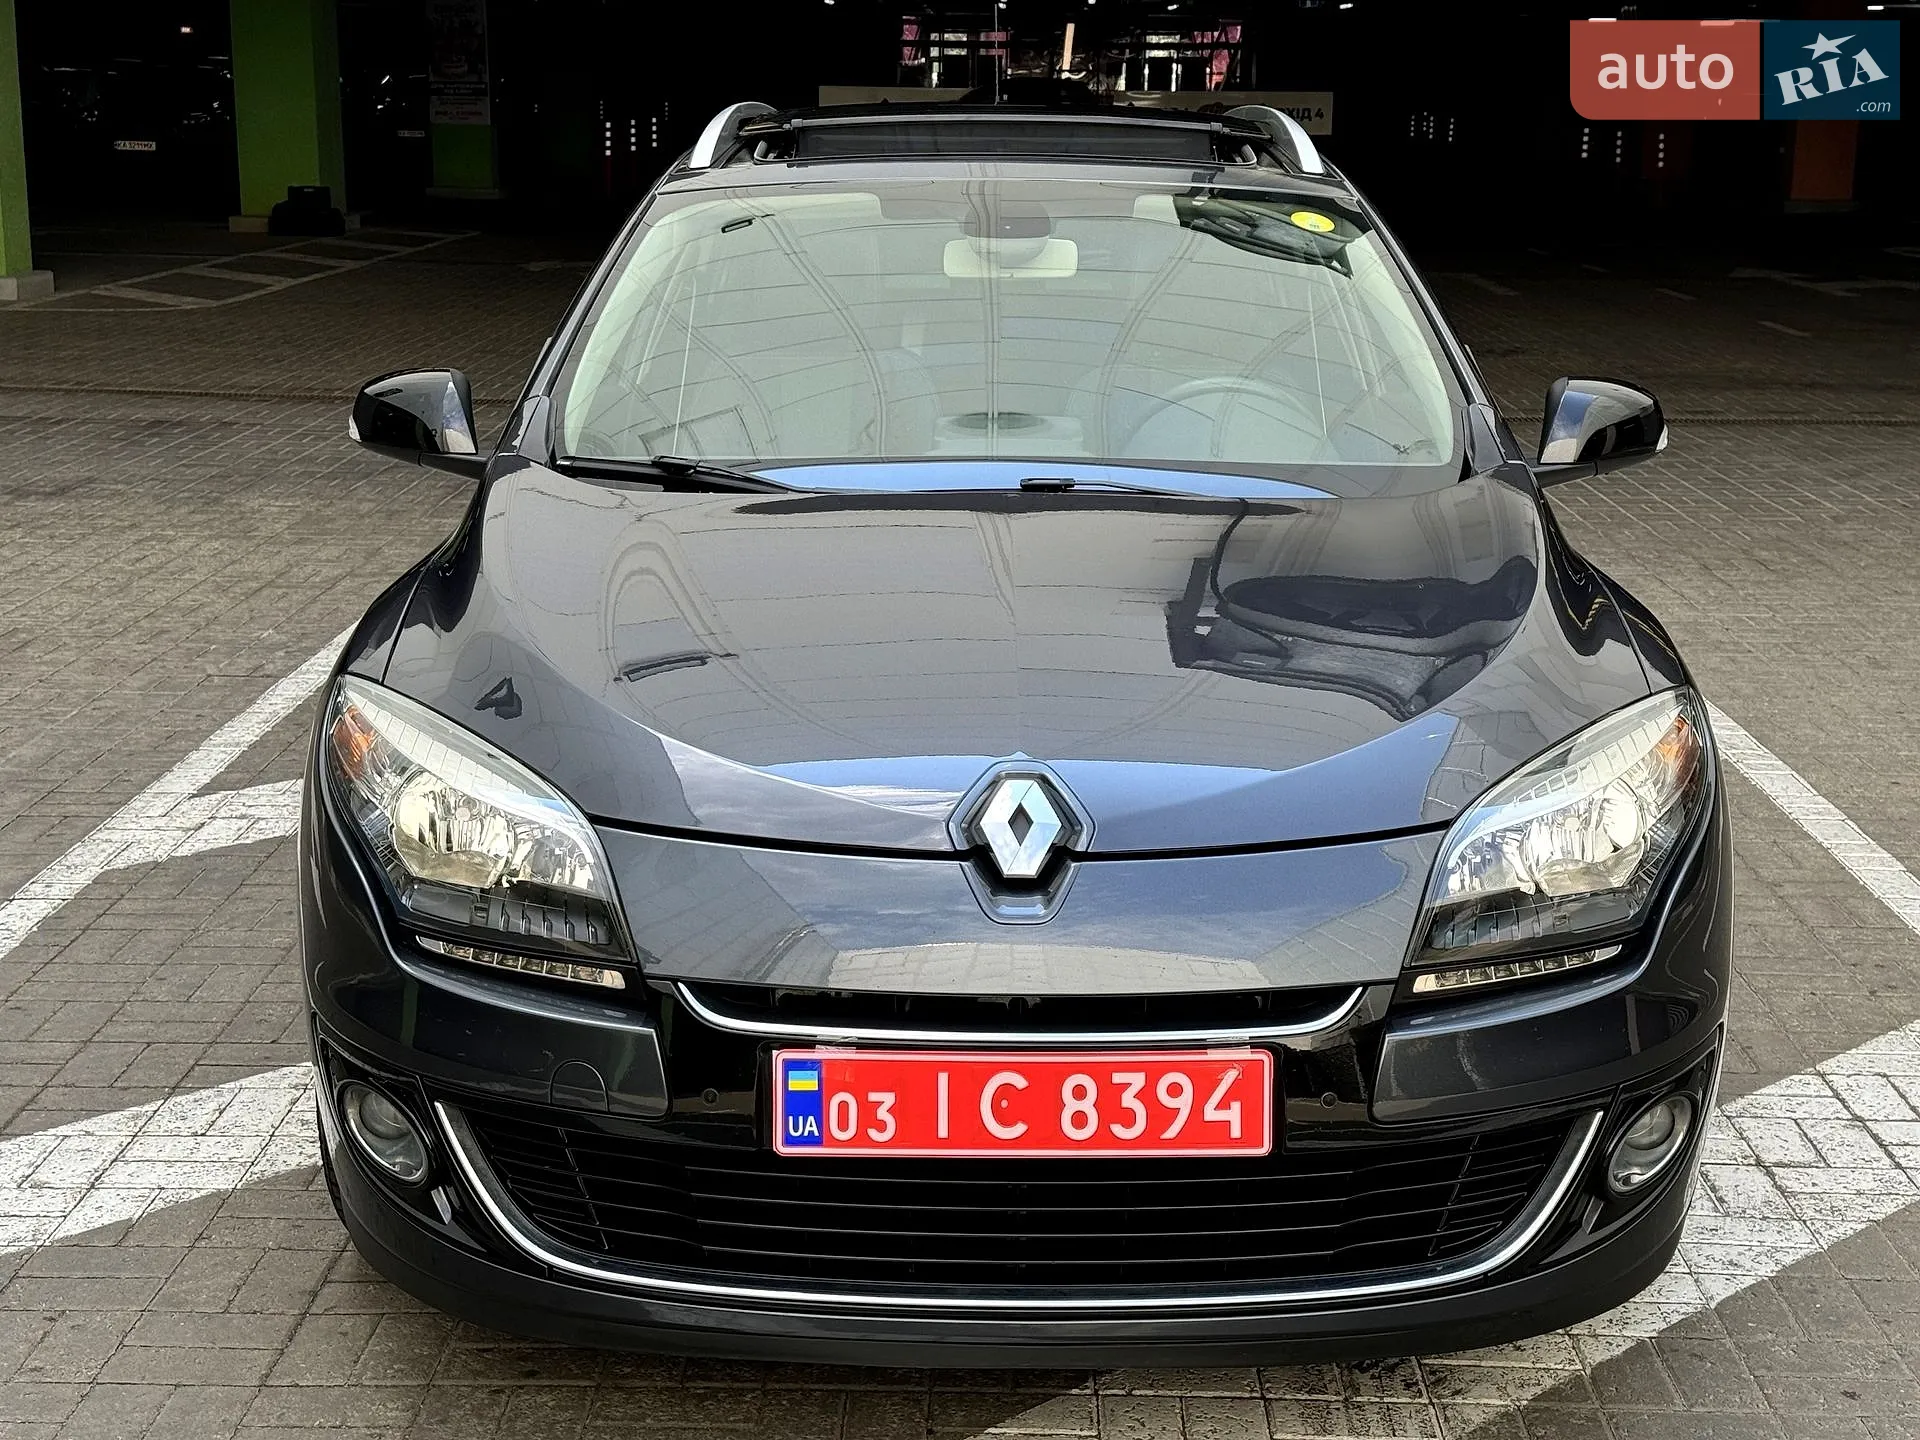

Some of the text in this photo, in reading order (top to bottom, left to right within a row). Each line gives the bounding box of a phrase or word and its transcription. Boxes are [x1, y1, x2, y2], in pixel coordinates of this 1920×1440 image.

[1314, 107, 1325, 120] 4
[828, 1091, 897, 1143] 03
[1060, 1070, 1243, 1141] 8394
[788, 1115, 820, 1138] UA
